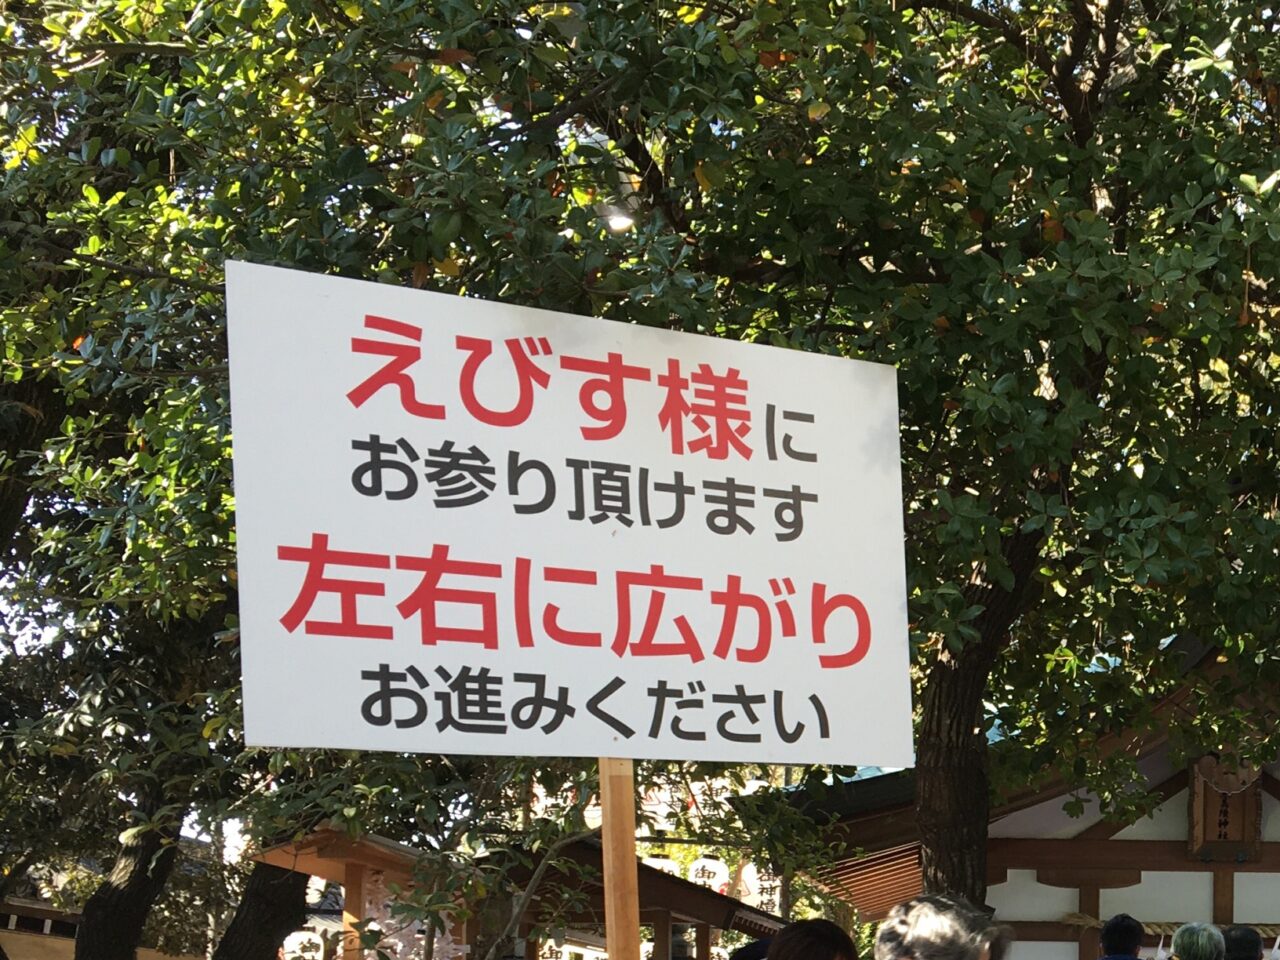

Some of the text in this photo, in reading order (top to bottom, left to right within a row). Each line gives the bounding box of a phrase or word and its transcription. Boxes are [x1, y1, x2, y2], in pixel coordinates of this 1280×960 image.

[346, 314, 818, 464] えびす様に
[351, 434, 819, 543] お参り頂けます
[277, 533, 872, 669] 左右に広がり
[360, 663, 830, 744] お進みください
